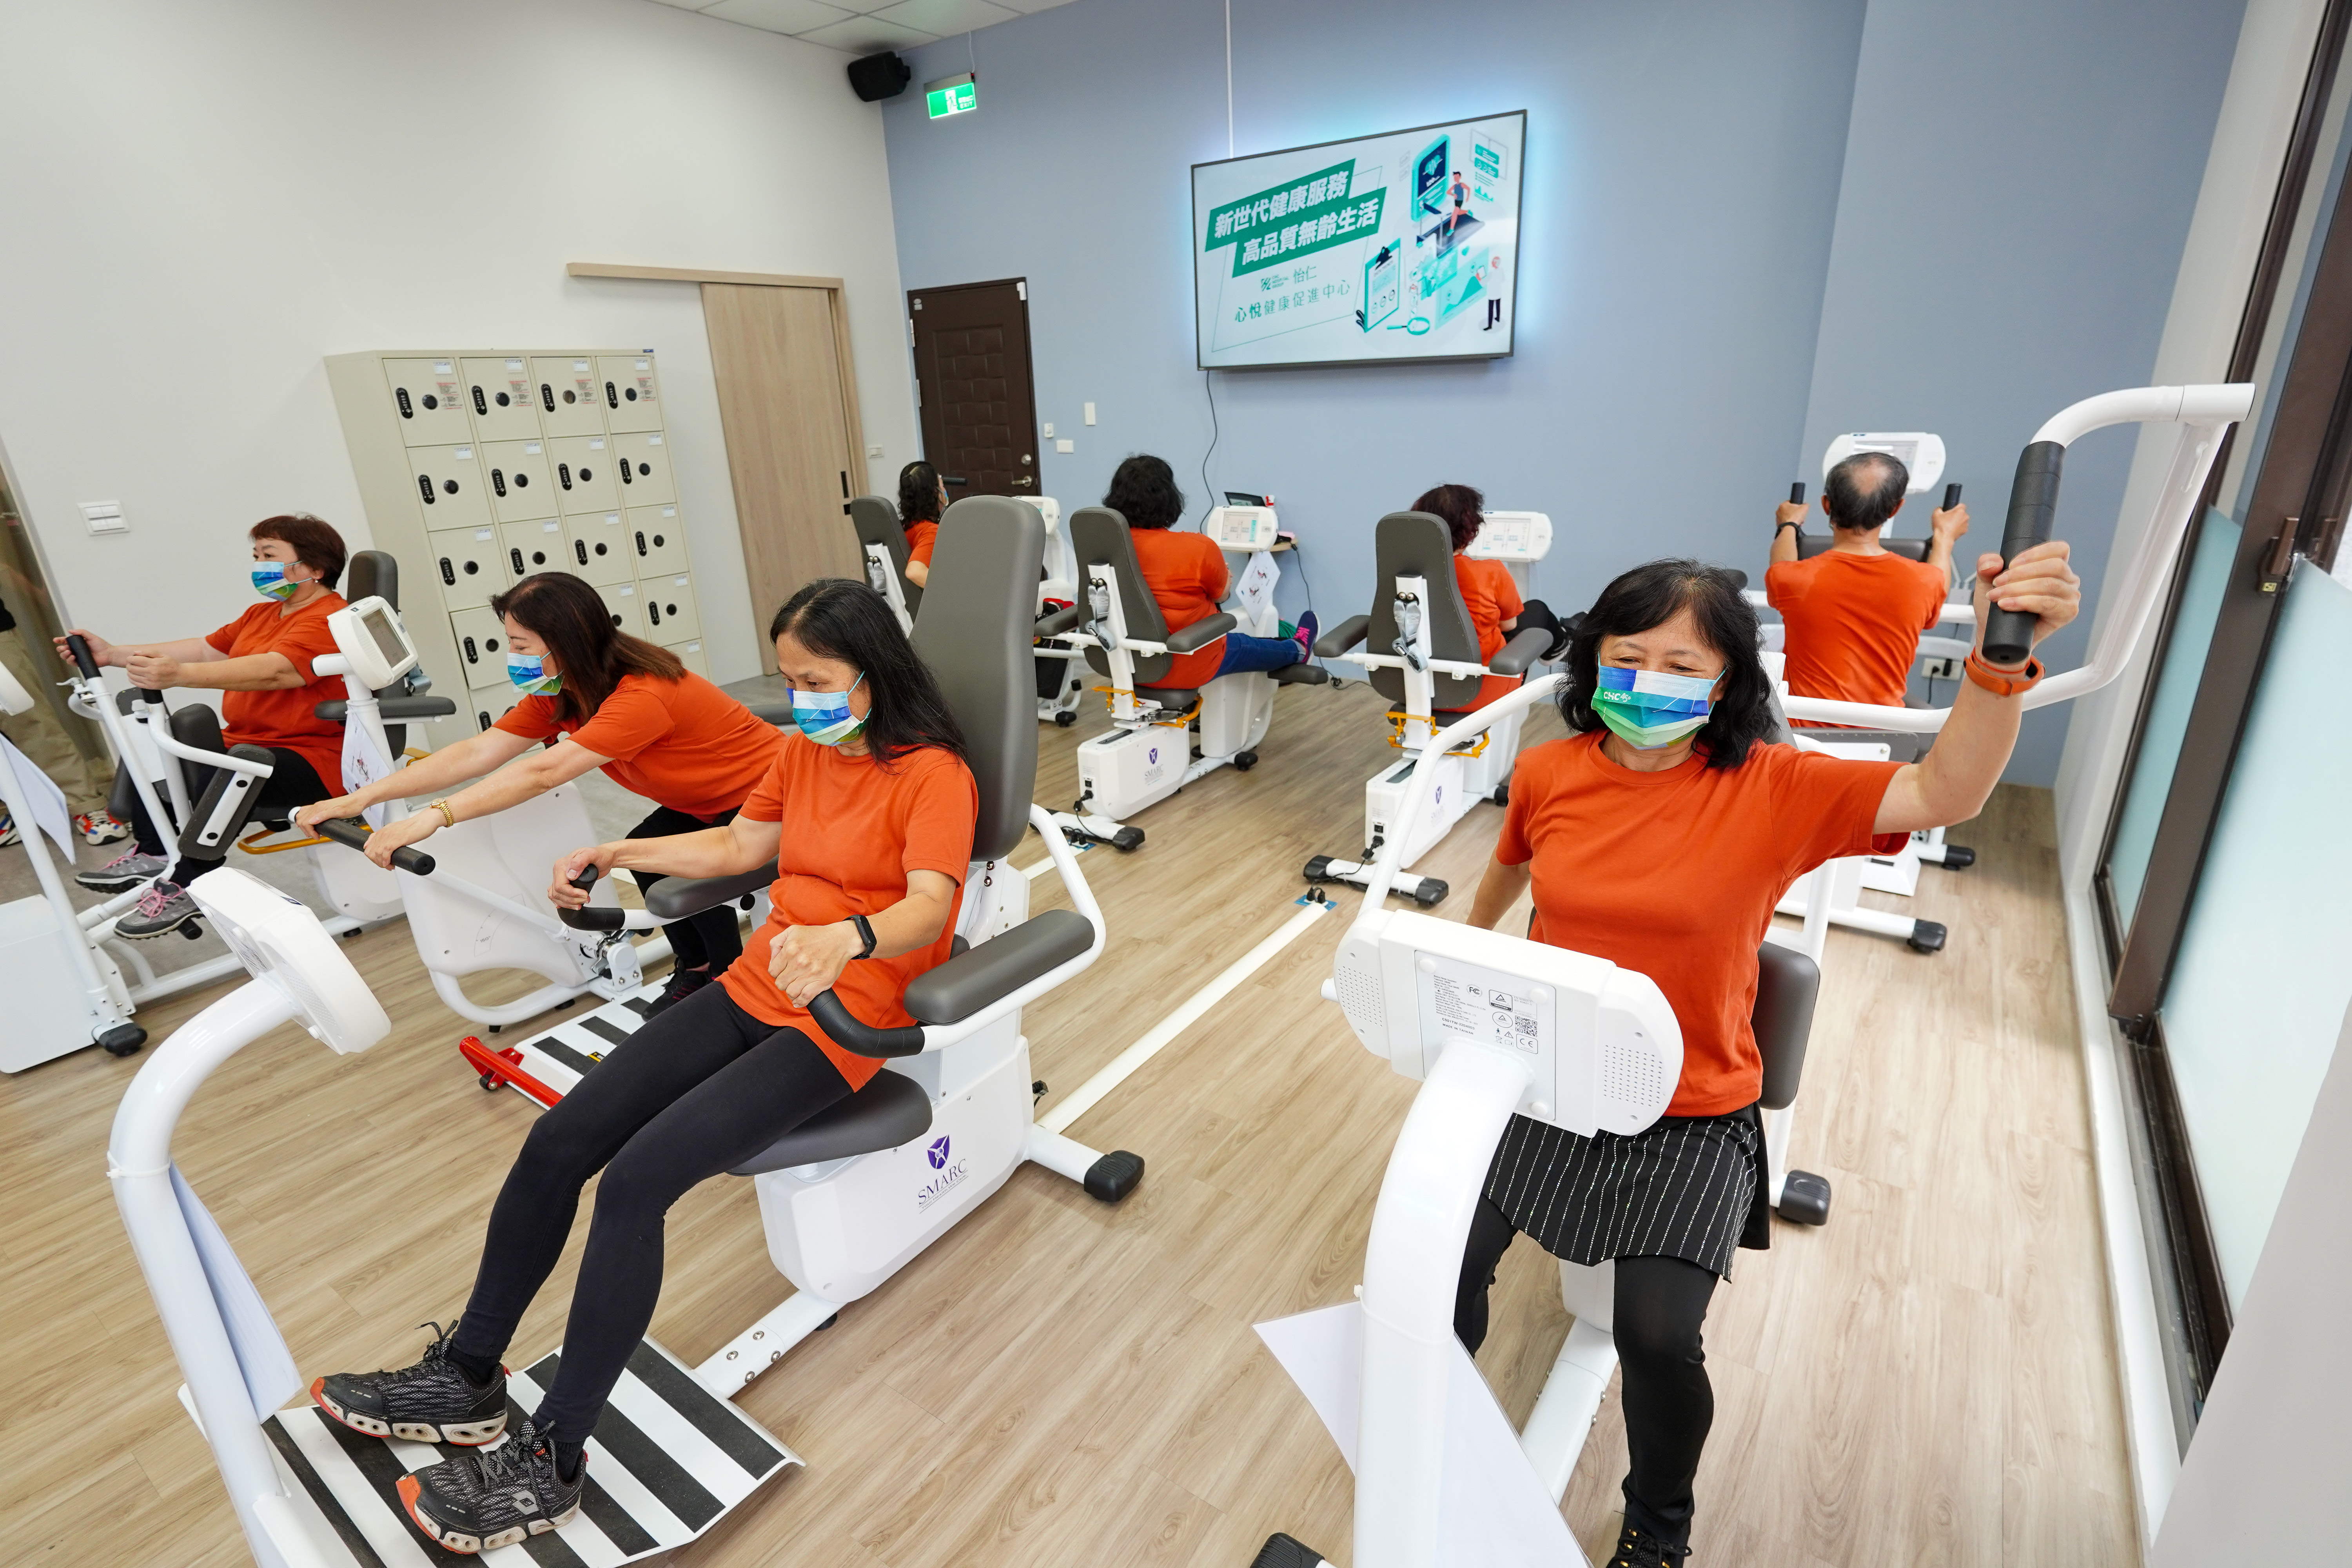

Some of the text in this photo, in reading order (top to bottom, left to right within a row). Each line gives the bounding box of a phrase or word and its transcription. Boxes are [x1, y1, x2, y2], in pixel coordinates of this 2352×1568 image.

[1215, 171, 1349, 238] 新世代健康服務
[1242, 198, 1379, 265] 高品質無齡生活
[1293, 266, 1316, 284] 怡仁
[1235, 279, 1350, 322] 心悅健康促進中心
[918, 1158, 967, 1205] SMARC
